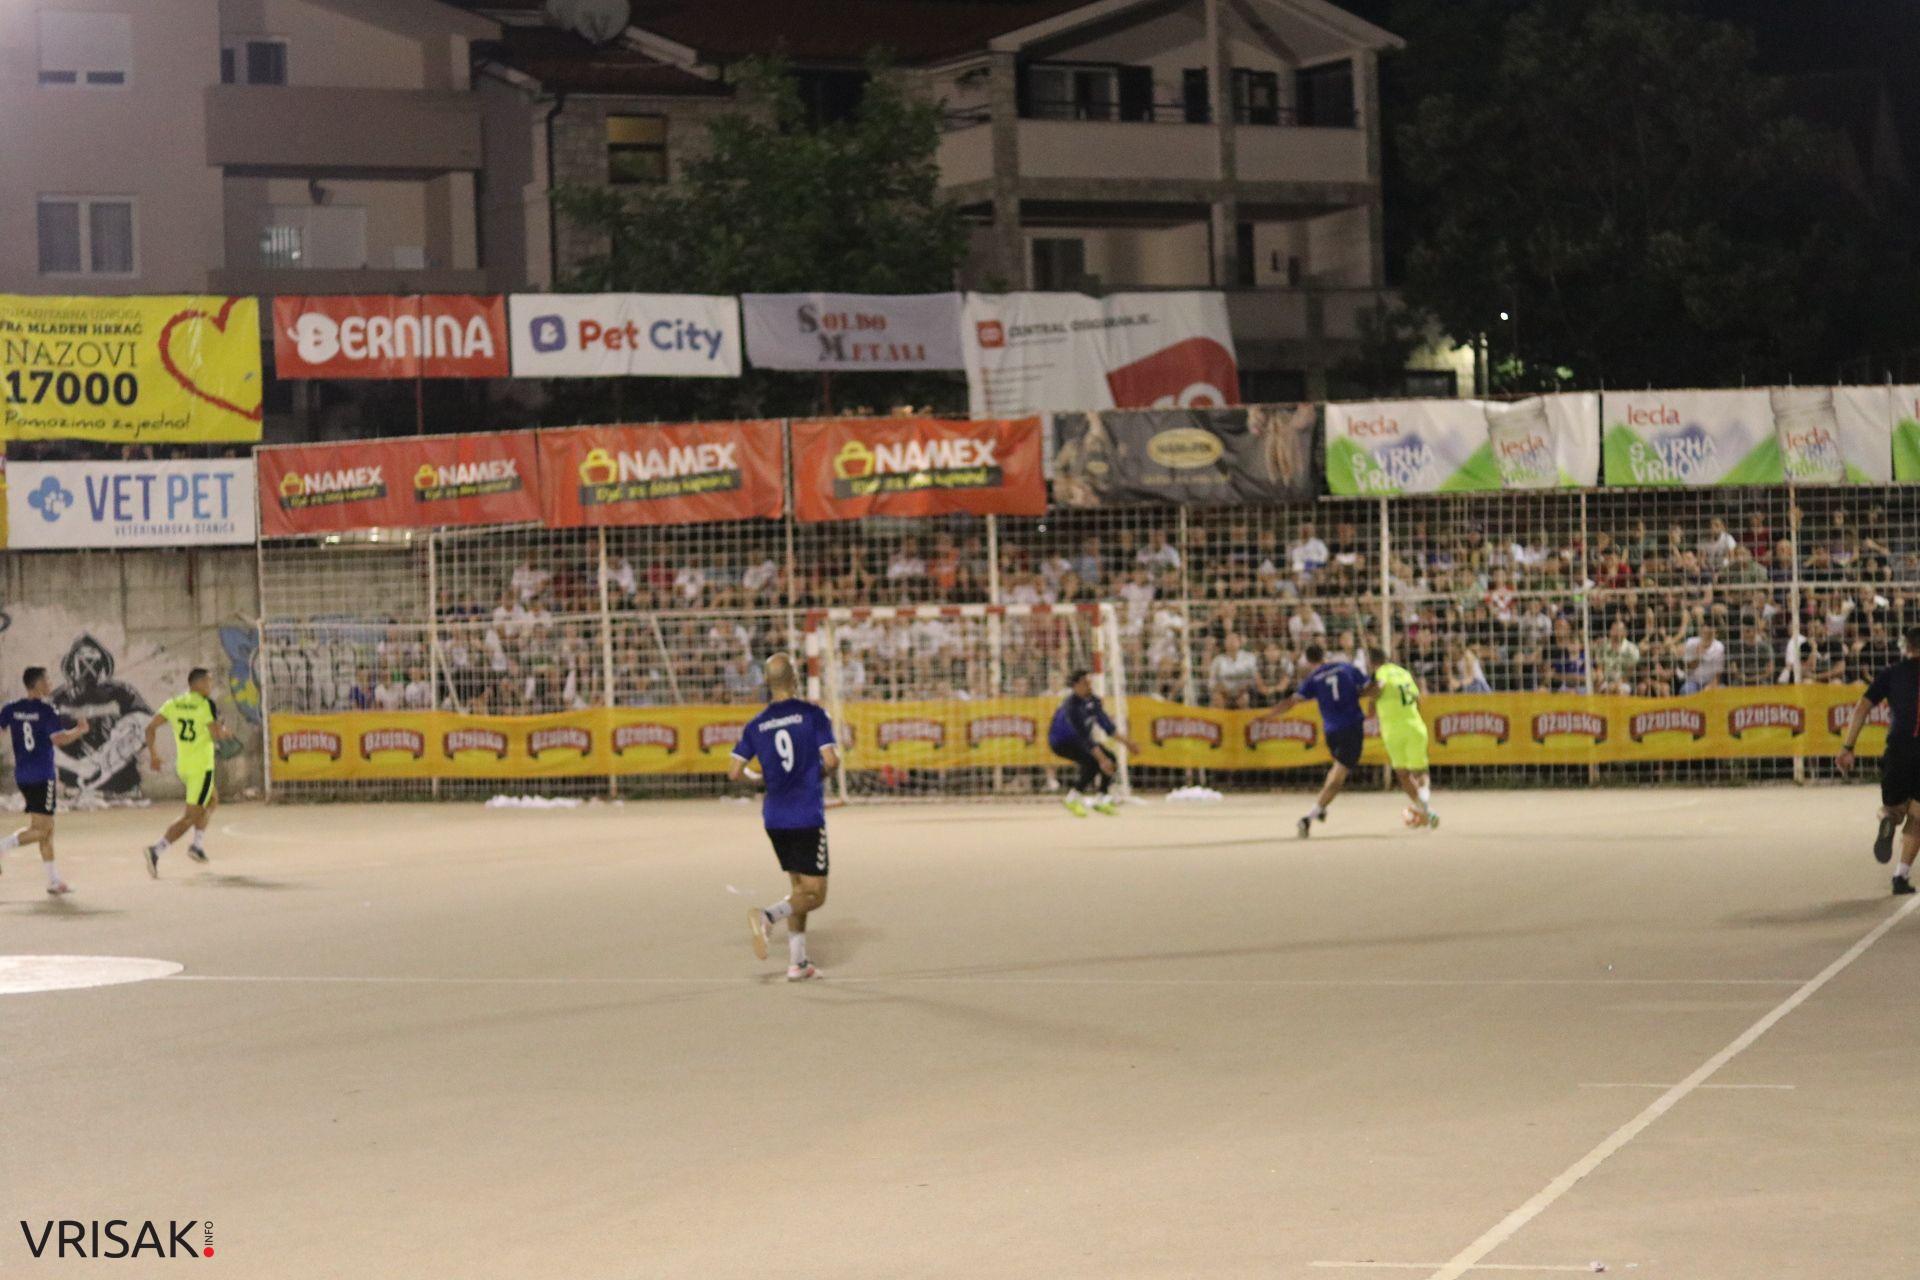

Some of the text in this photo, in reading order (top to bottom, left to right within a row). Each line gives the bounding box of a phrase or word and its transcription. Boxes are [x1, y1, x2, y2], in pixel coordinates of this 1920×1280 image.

[5, 339, 138, 368] NAZOVI
[579, 319, 723, 360] Pet City
[5, 370, 139, 407] 17000
[1346, 415, 1400, 437] leda
[1627, 404, 1681, 425] leda
[618, 442, 738, 483] NAMEX
[873, 438, 998, 474] NAMEX
[303, 465, 384, 495] NAMEX
[438, 458, 517, 487] NAMEX
[85, 474, 157, 521] VET
[166, 472, 235, 520] PET
[1324, 674, 1341, 701] 7
[23, 721, 35, 751] 8
[178, 718, 196, 742] 23
[774, 729, 795, 773] 9
